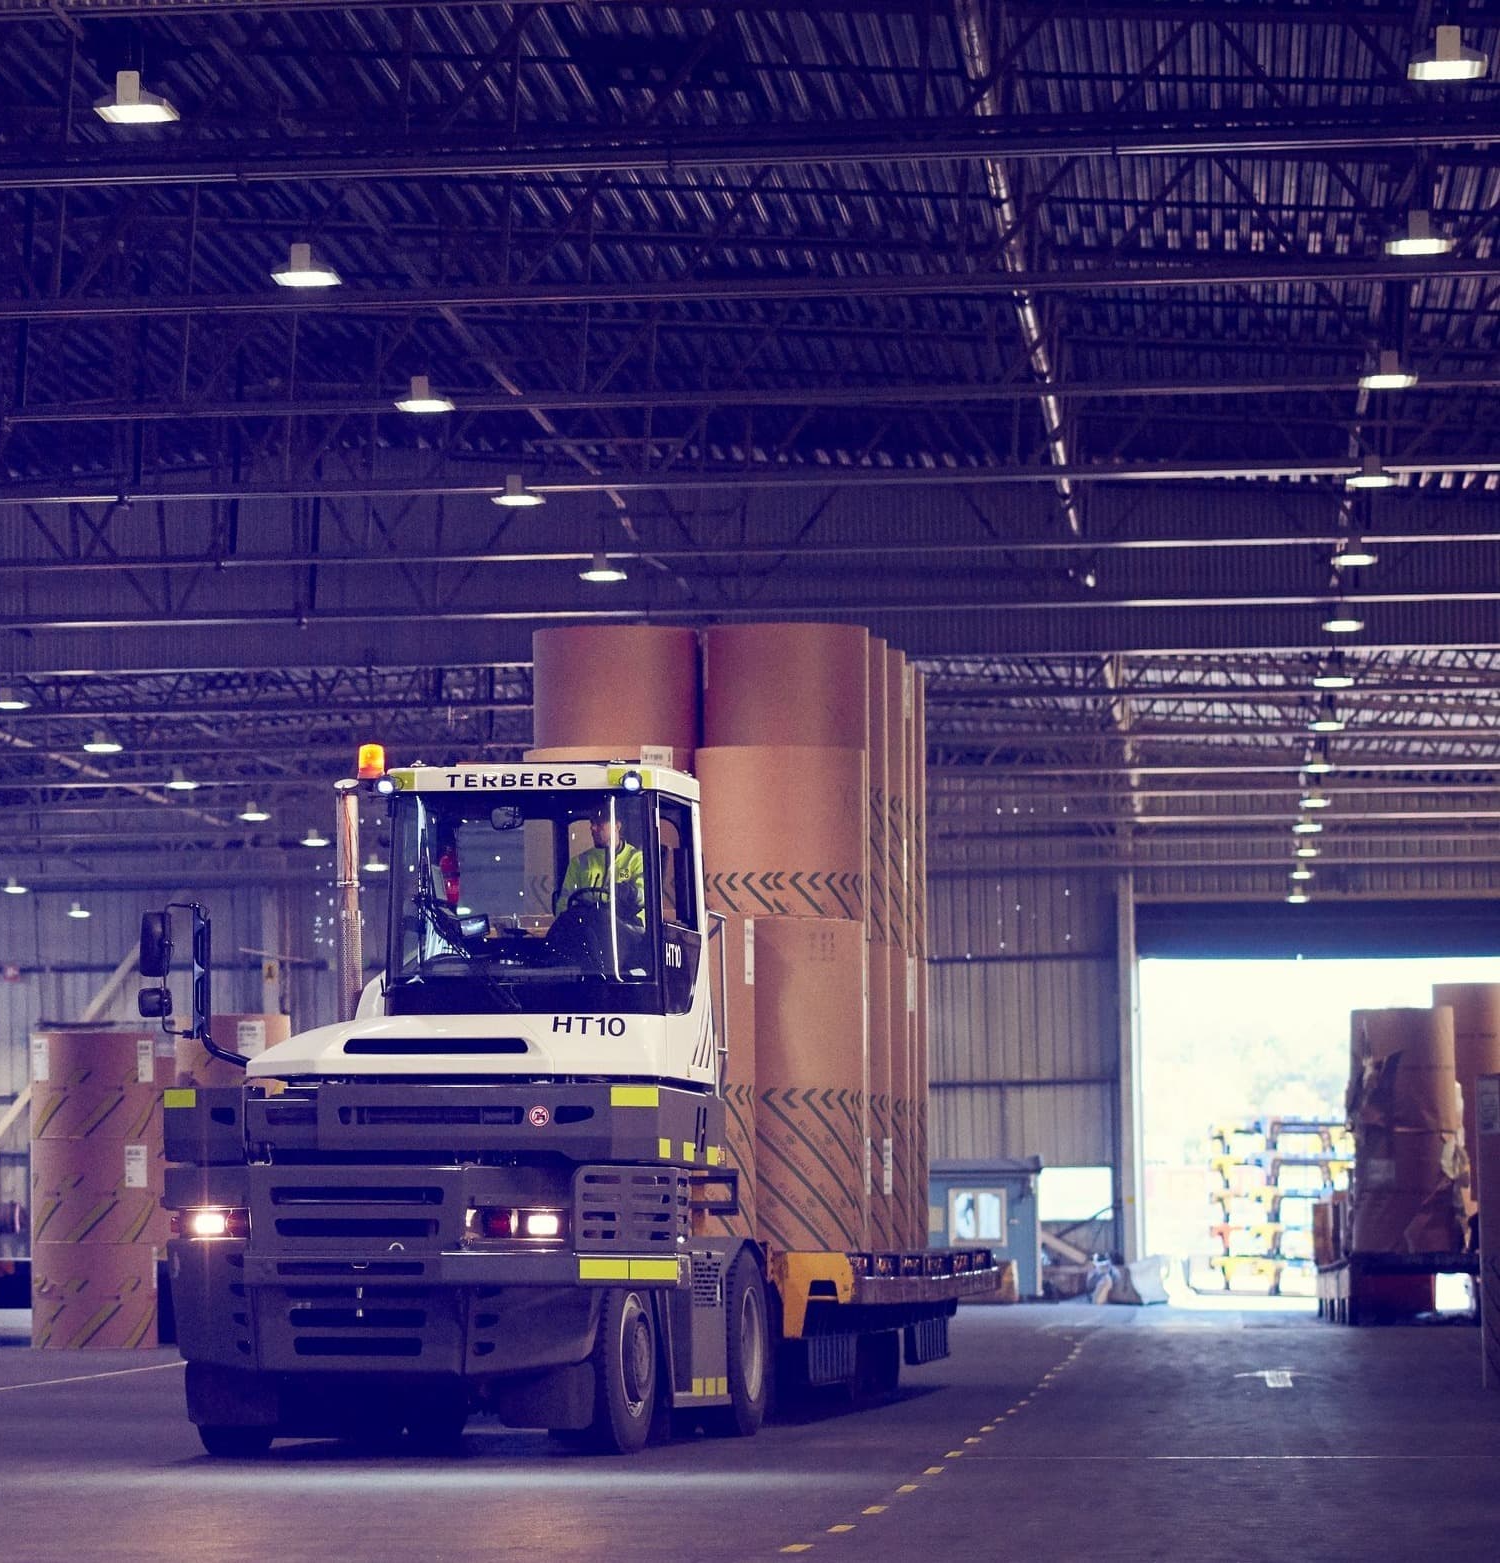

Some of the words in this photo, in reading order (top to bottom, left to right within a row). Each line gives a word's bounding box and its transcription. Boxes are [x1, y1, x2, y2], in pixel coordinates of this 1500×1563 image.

[446, 772, 577, 789] TERBERG
[665, 942, 682, 969] HT10
[552, 1015, 626, 1037] HT10
